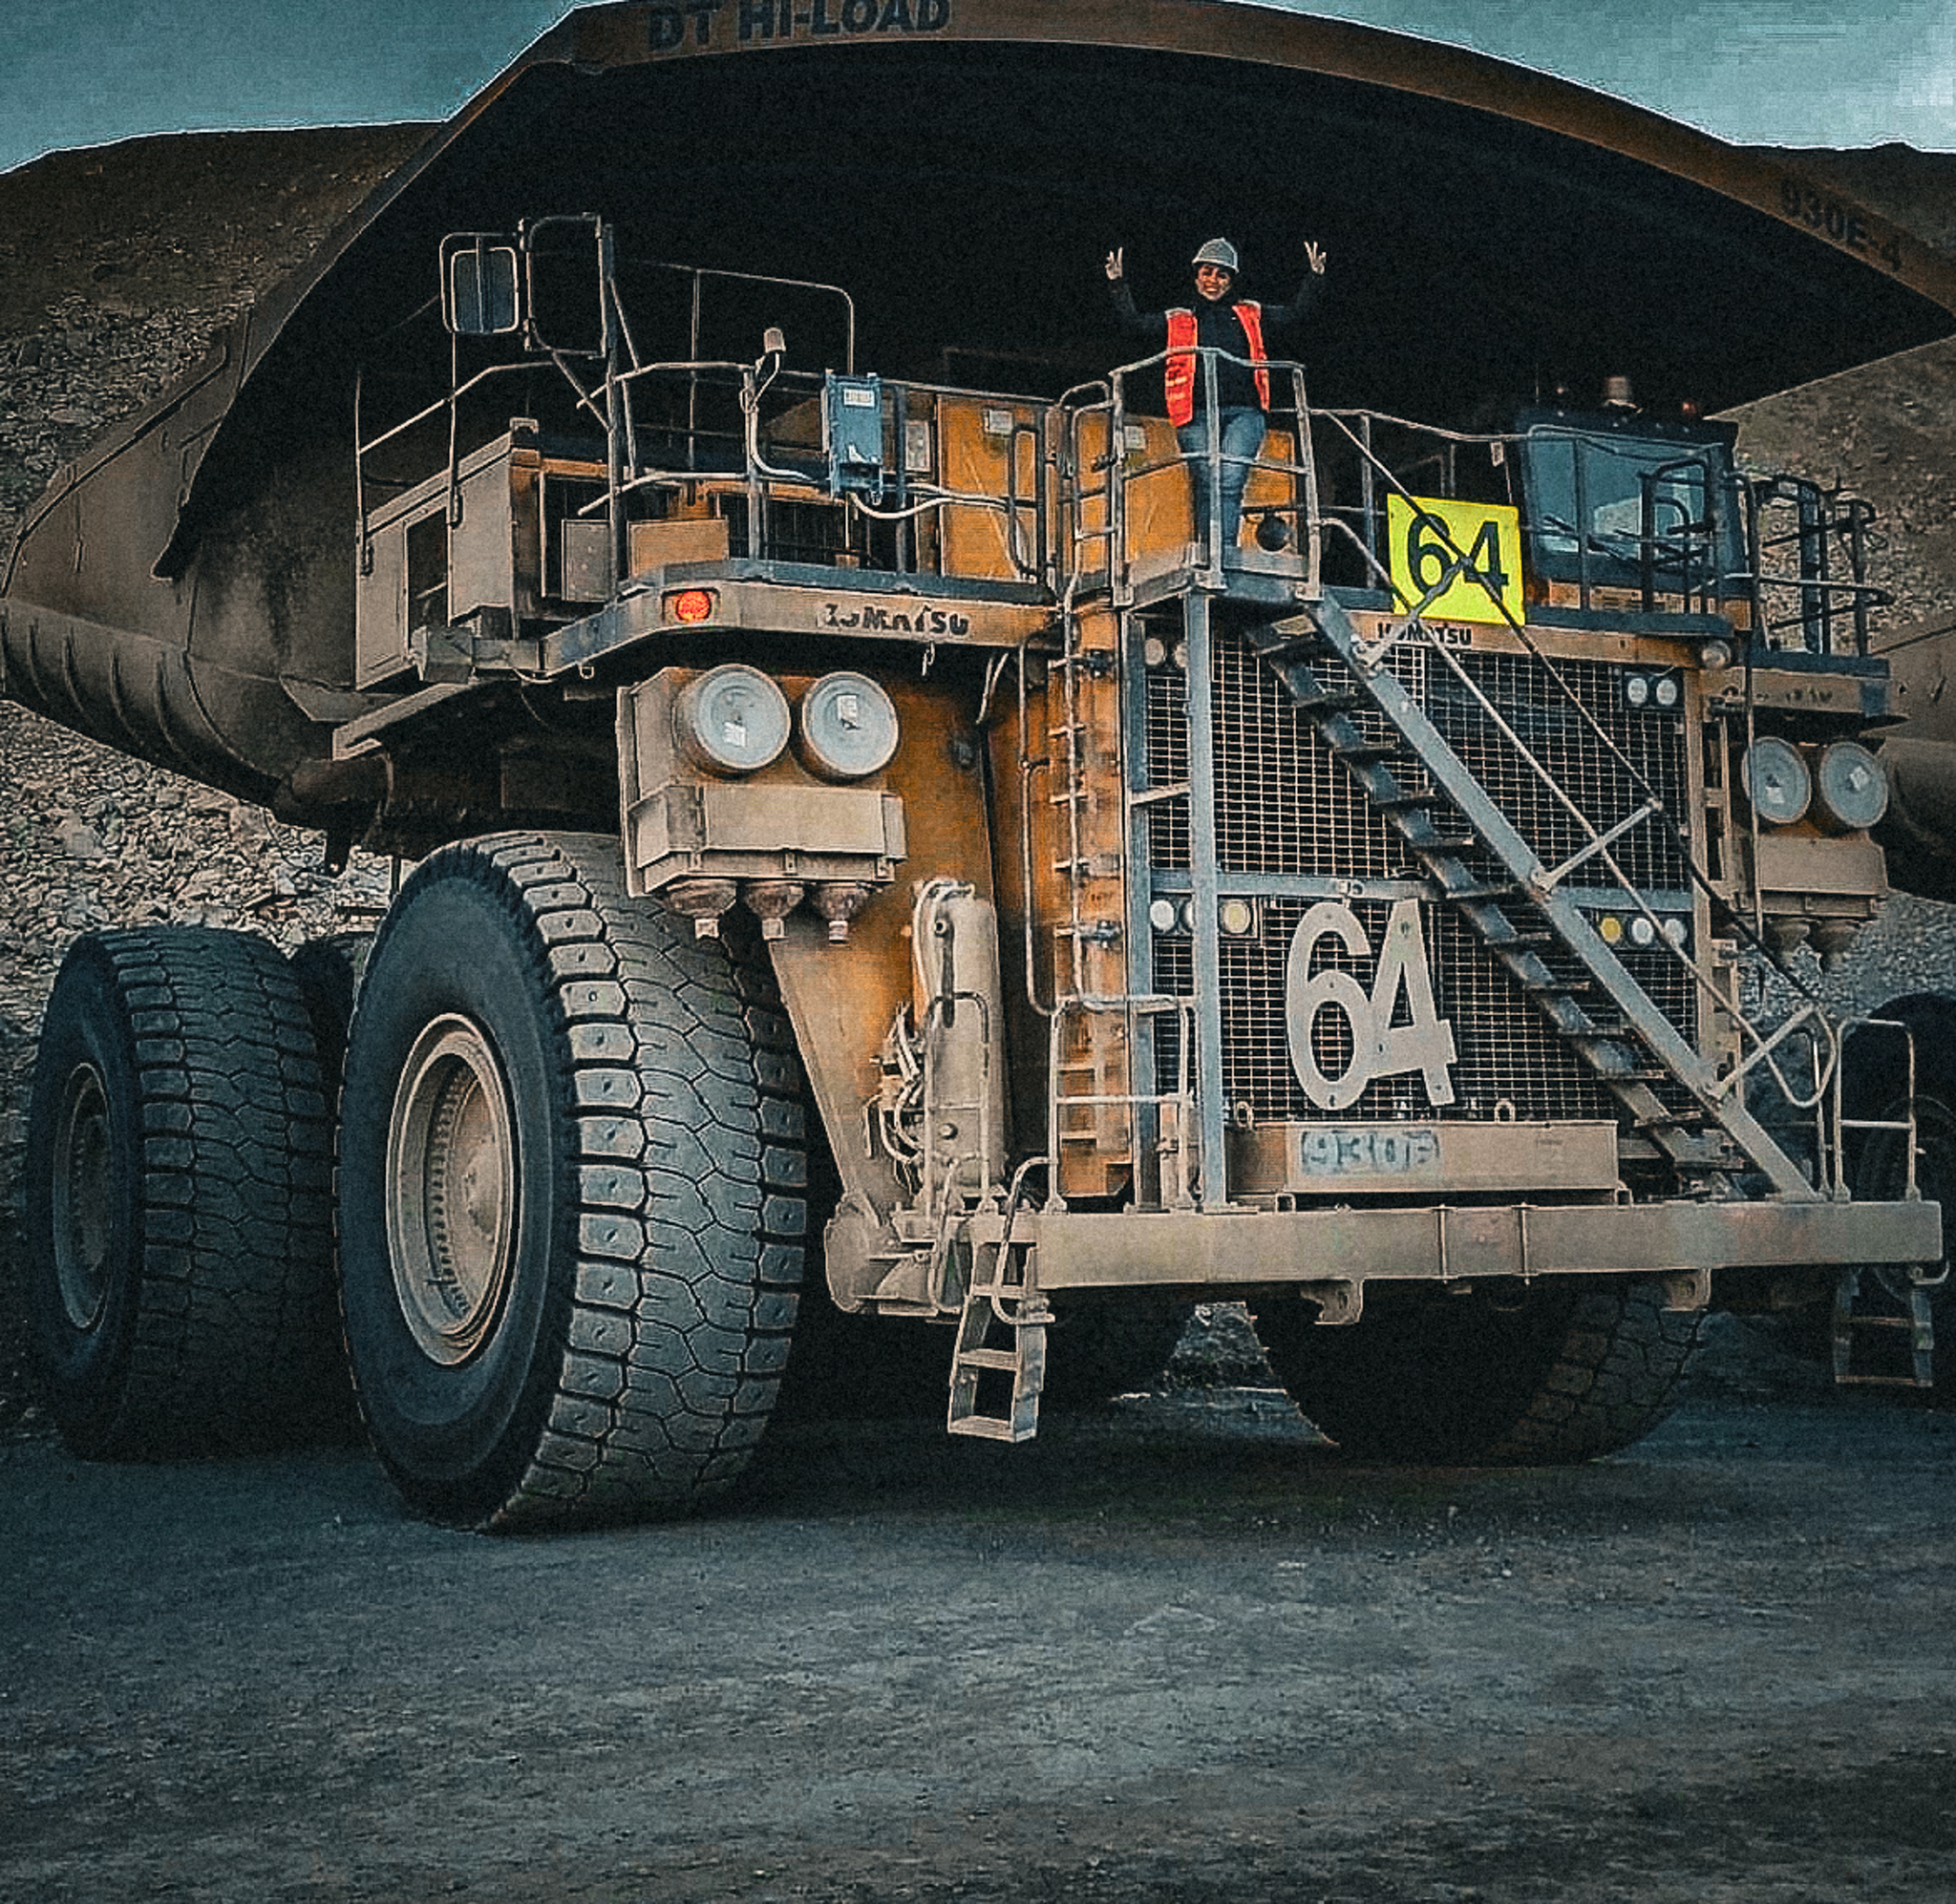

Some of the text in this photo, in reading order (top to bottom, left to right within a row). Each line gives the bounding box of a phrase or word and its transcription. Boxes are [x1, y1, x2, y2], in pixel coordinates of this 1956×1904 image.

[647, 0, 952, 50] DT HI-LOAD
[1781, 179, 1901, 272] 930E-4
[1407, 512, 1510, 601] 64
[1377, 622, 1472, 645] KMTSU
[1286, 899, 1457, 1111] 64
